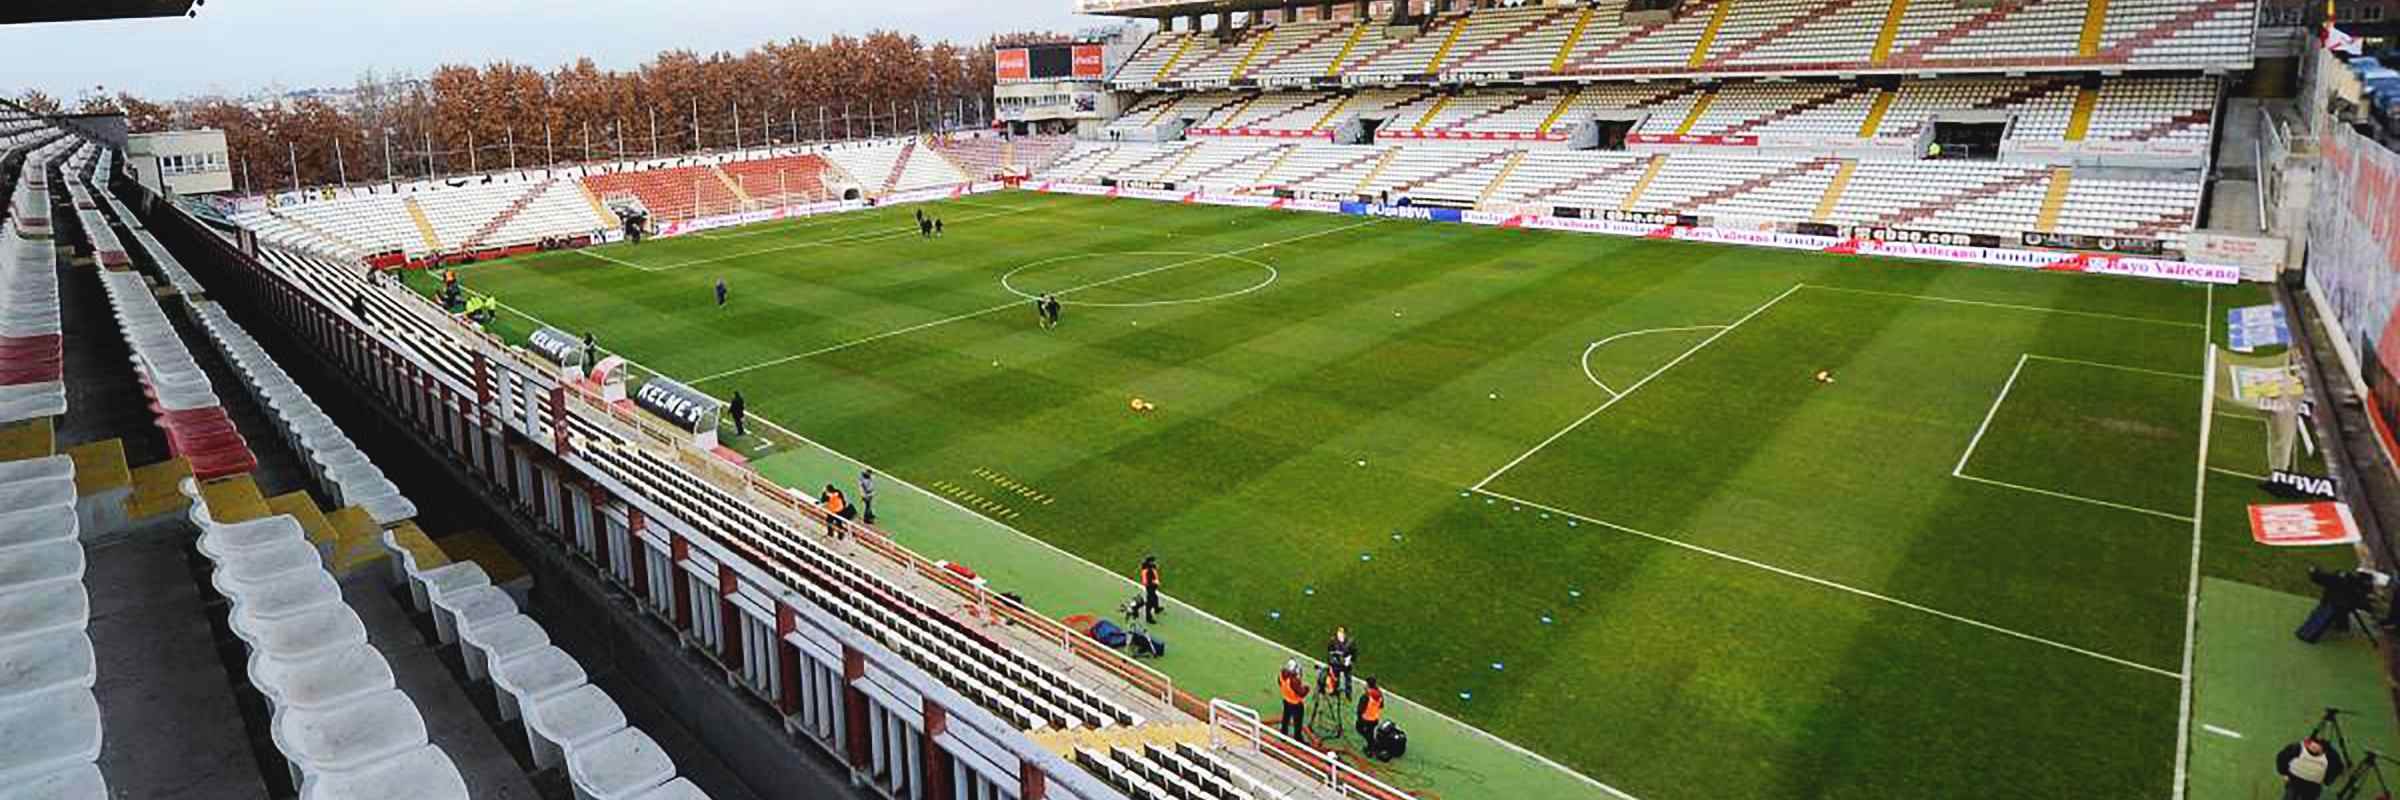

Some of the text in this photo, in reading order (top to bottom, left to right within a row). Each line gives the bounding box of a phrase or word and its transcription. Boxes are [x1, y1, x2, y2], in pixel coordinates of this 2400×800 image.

[2105, 259, 2237, 280] Rayo Vallecano
[637, 382, 692, 418] KELME
